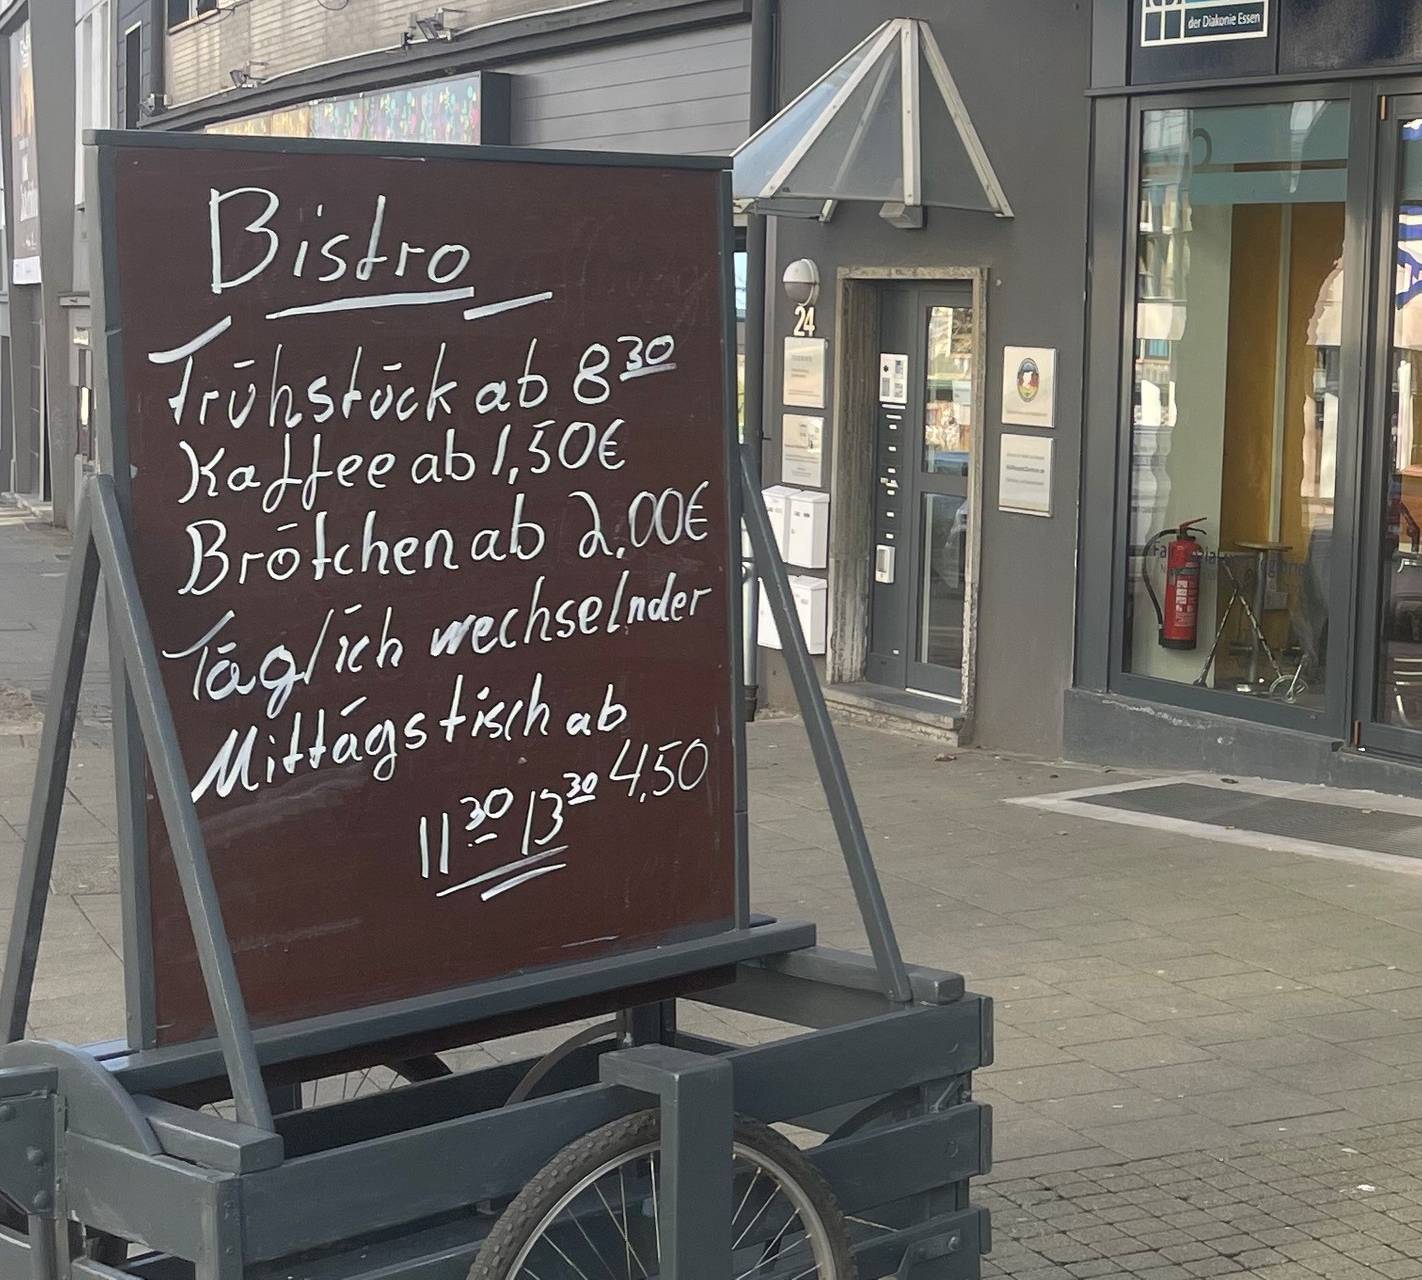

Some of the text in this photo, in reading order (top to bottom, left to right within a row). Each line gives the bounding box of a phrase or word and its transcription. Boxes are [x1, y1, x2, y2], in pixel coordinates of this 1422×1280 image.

[1188, 11, 1260, 29] der Diakonie Essen
[208, 187, 471, 296] Bistro
[793, 305, 816, 337] 24
[475, 338, 549, 415] ab
[177, 432, 397, 514] Kaffee
[410, 428, 476, 484] ab
[177, 510, 459, 596] Brötchen
[470, 493, 545, 561] ab
[162, 571, 713, 719] Täglich wechselnder
[564, 684, 628, 736] ab
[609, 738, 710, 804] 4,50
